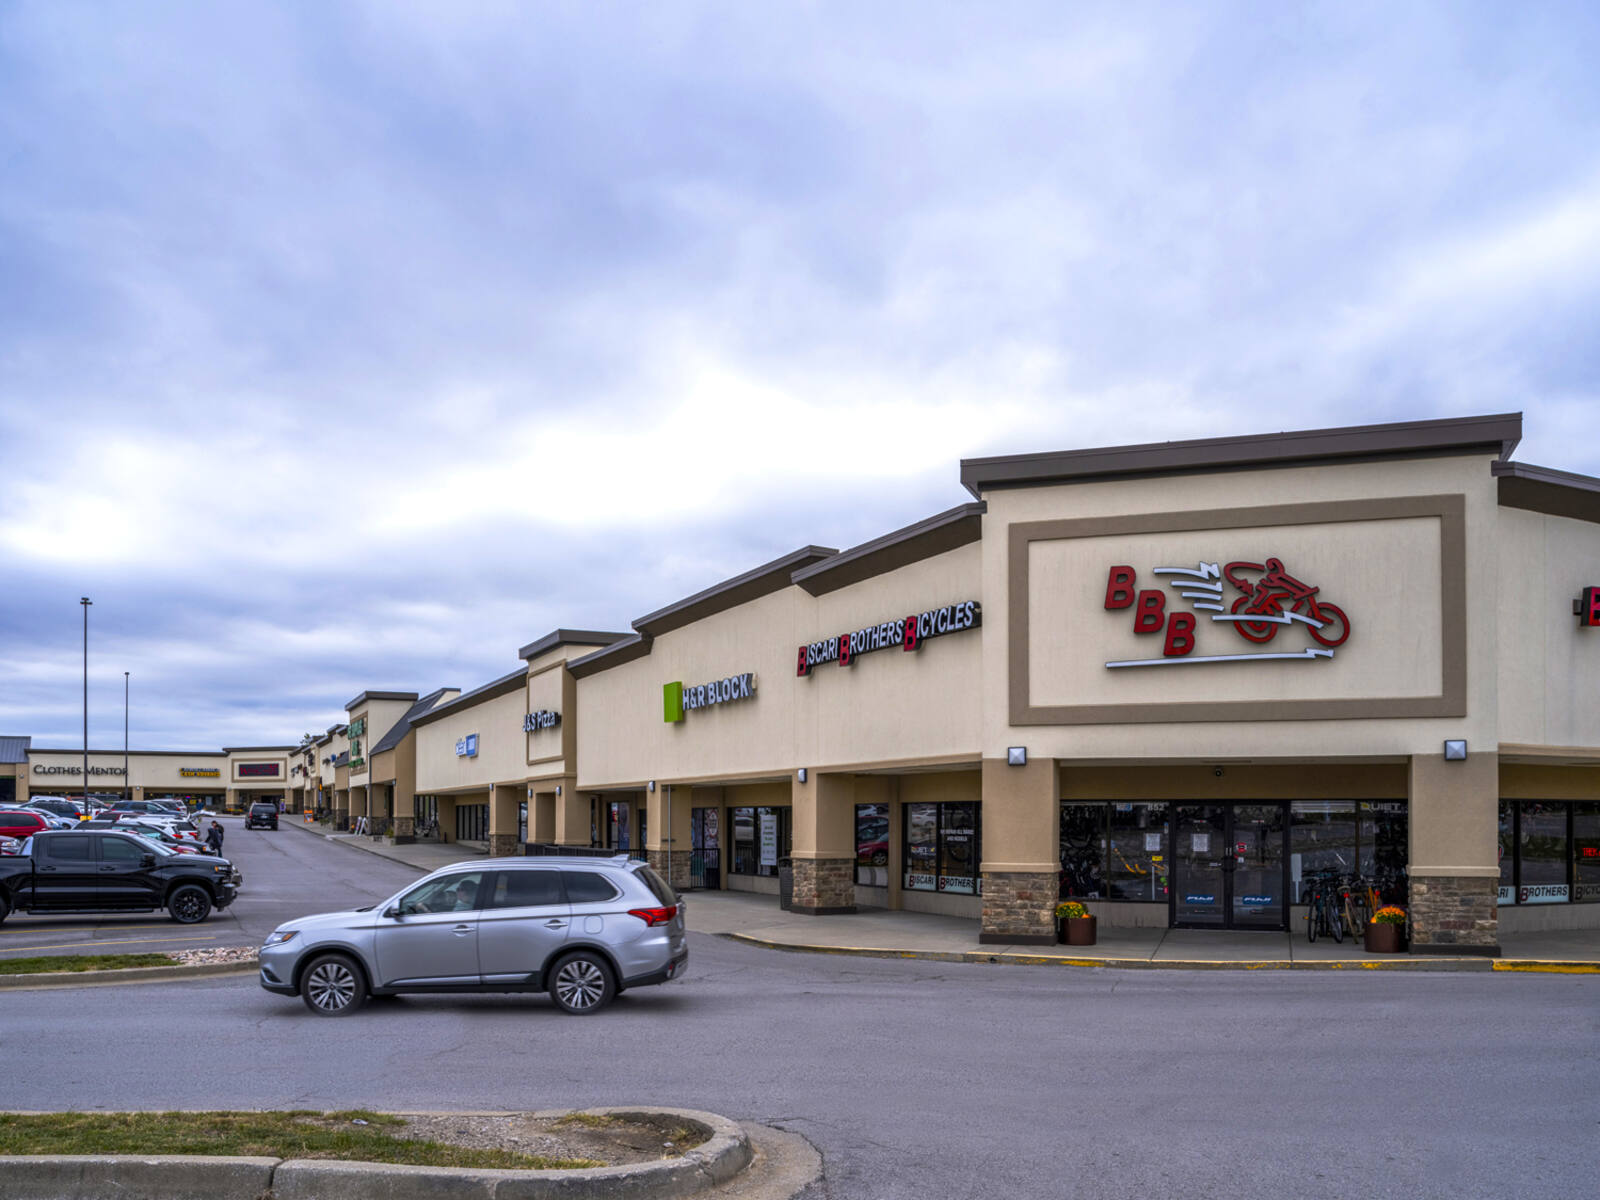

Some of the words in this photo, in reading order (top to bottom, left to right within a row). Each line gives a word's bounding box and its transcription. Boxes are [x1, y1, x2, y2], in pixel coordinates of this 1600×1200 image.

[797, 637, 839, 677] BISCARI
[839, 619, 905, 667] BROTHERS
[903, 600, 976, 652] BICYCLES
[682, 684, 706, 711] H&R
[707, 673, 750, 705] BLOCK
[522, 713, 536, 732] J&S
[537, 710, 556, 729] Pizza
[33, 764, 82, 776] CLOTHES
[86, 765, 129, 776] MENTOR
[909, 875, 934, 887] BISCARI
[939, 877, 975, 890] BROTHERS
[1520, 886, 1568, 901] BROTHERS
